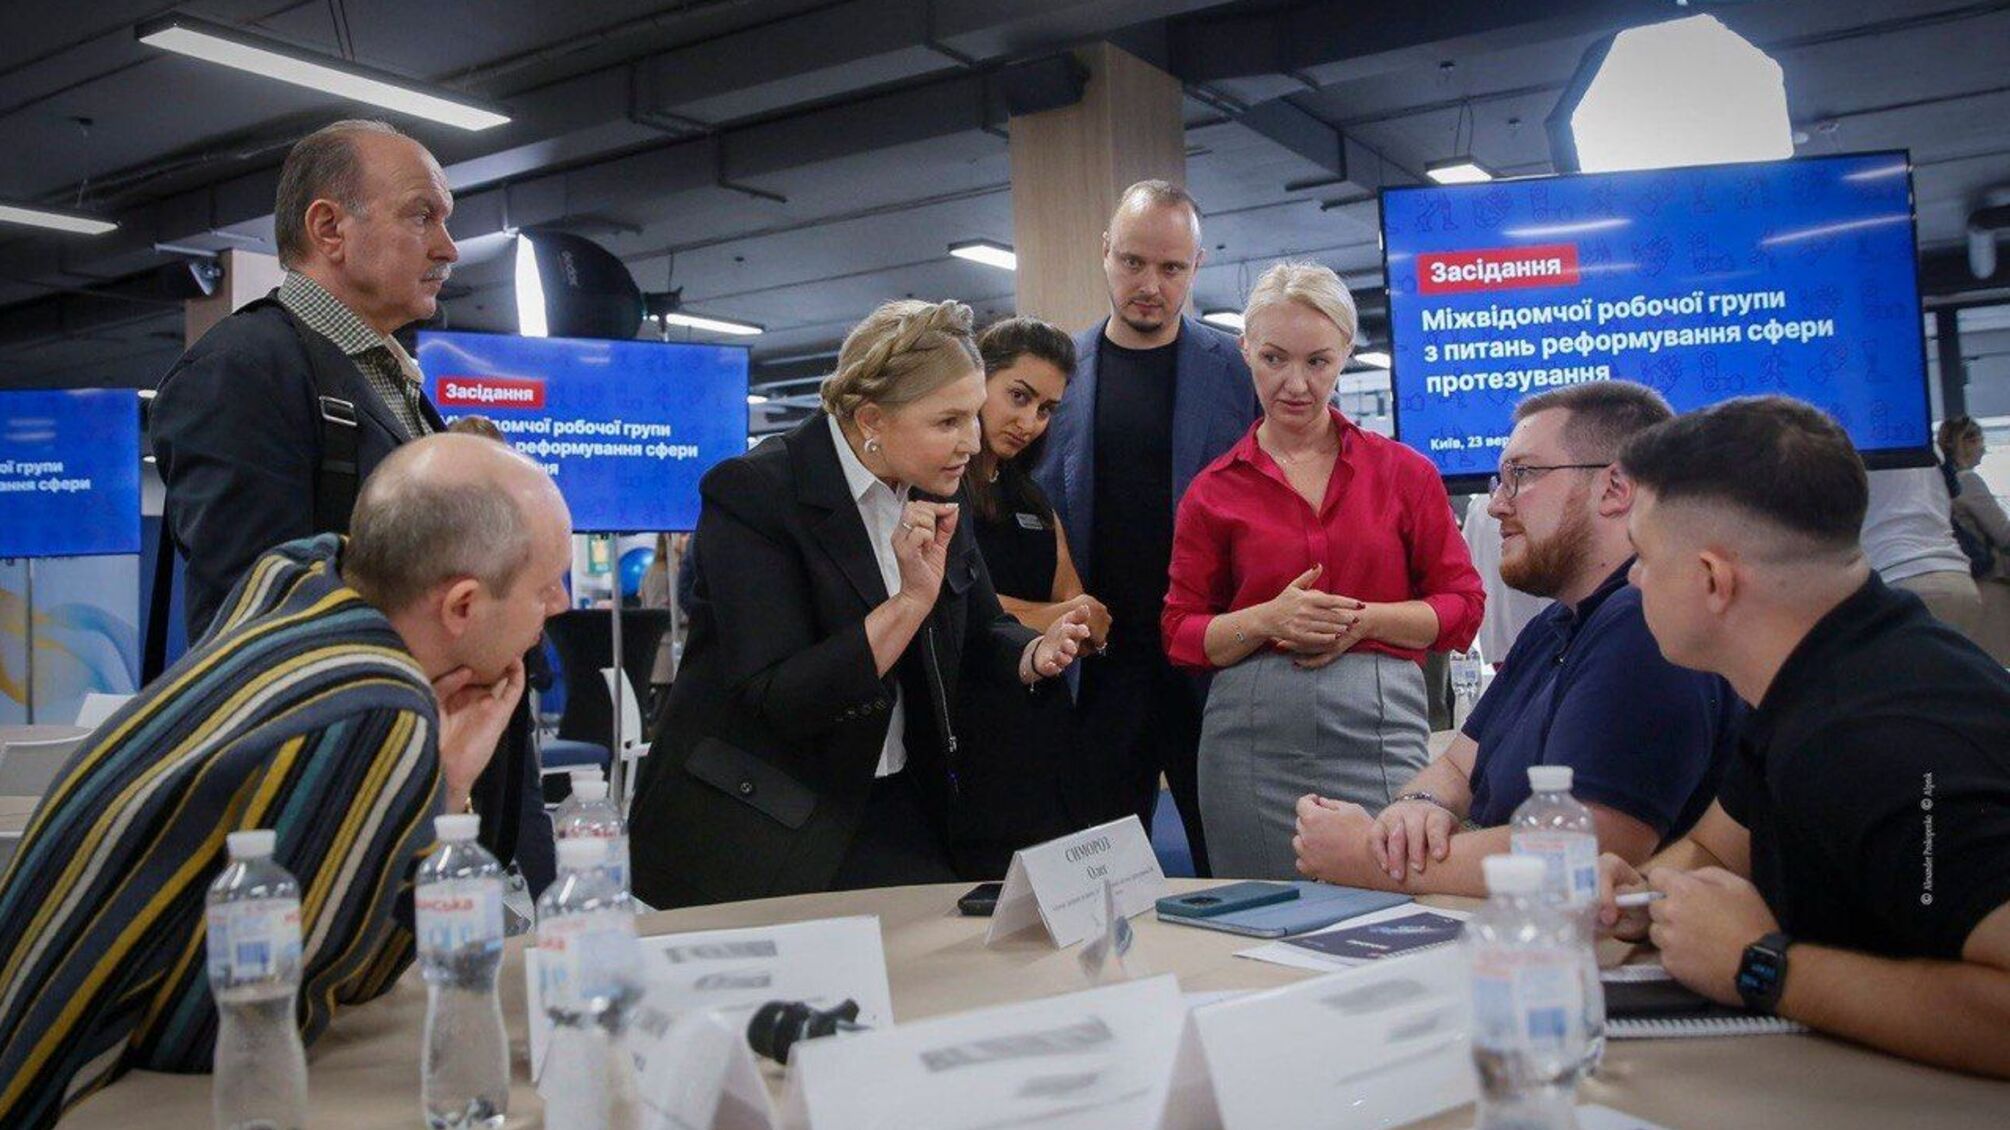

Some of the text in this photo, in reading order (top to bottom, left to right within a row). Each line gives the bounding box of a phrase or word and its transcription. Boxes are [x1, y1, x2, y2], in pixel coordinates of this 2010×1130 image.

[1430, 257, 1562, 284] Засідання
[1421, 290, 1787, 332] Міжвідомчої робочої групи
[1424, 319, 1835, 363] з питань реформування сфери
[1426, 362, 1611, 396] протезування
[445, 383, 534, 402] Засідання
[553, 419, 622, 438] робочої
[623, 423, 671, 440] групи
[515, 438, 699, 461] реформування сфери
[1430, 438, 1465, 451] Київ,
[1467, 436, 1484, 449] 23
[16, 461, 64, 477] групи
[37, 477, 91, 493] сфери
[1065, 835, 1113, 863] СИМОРОЗ
